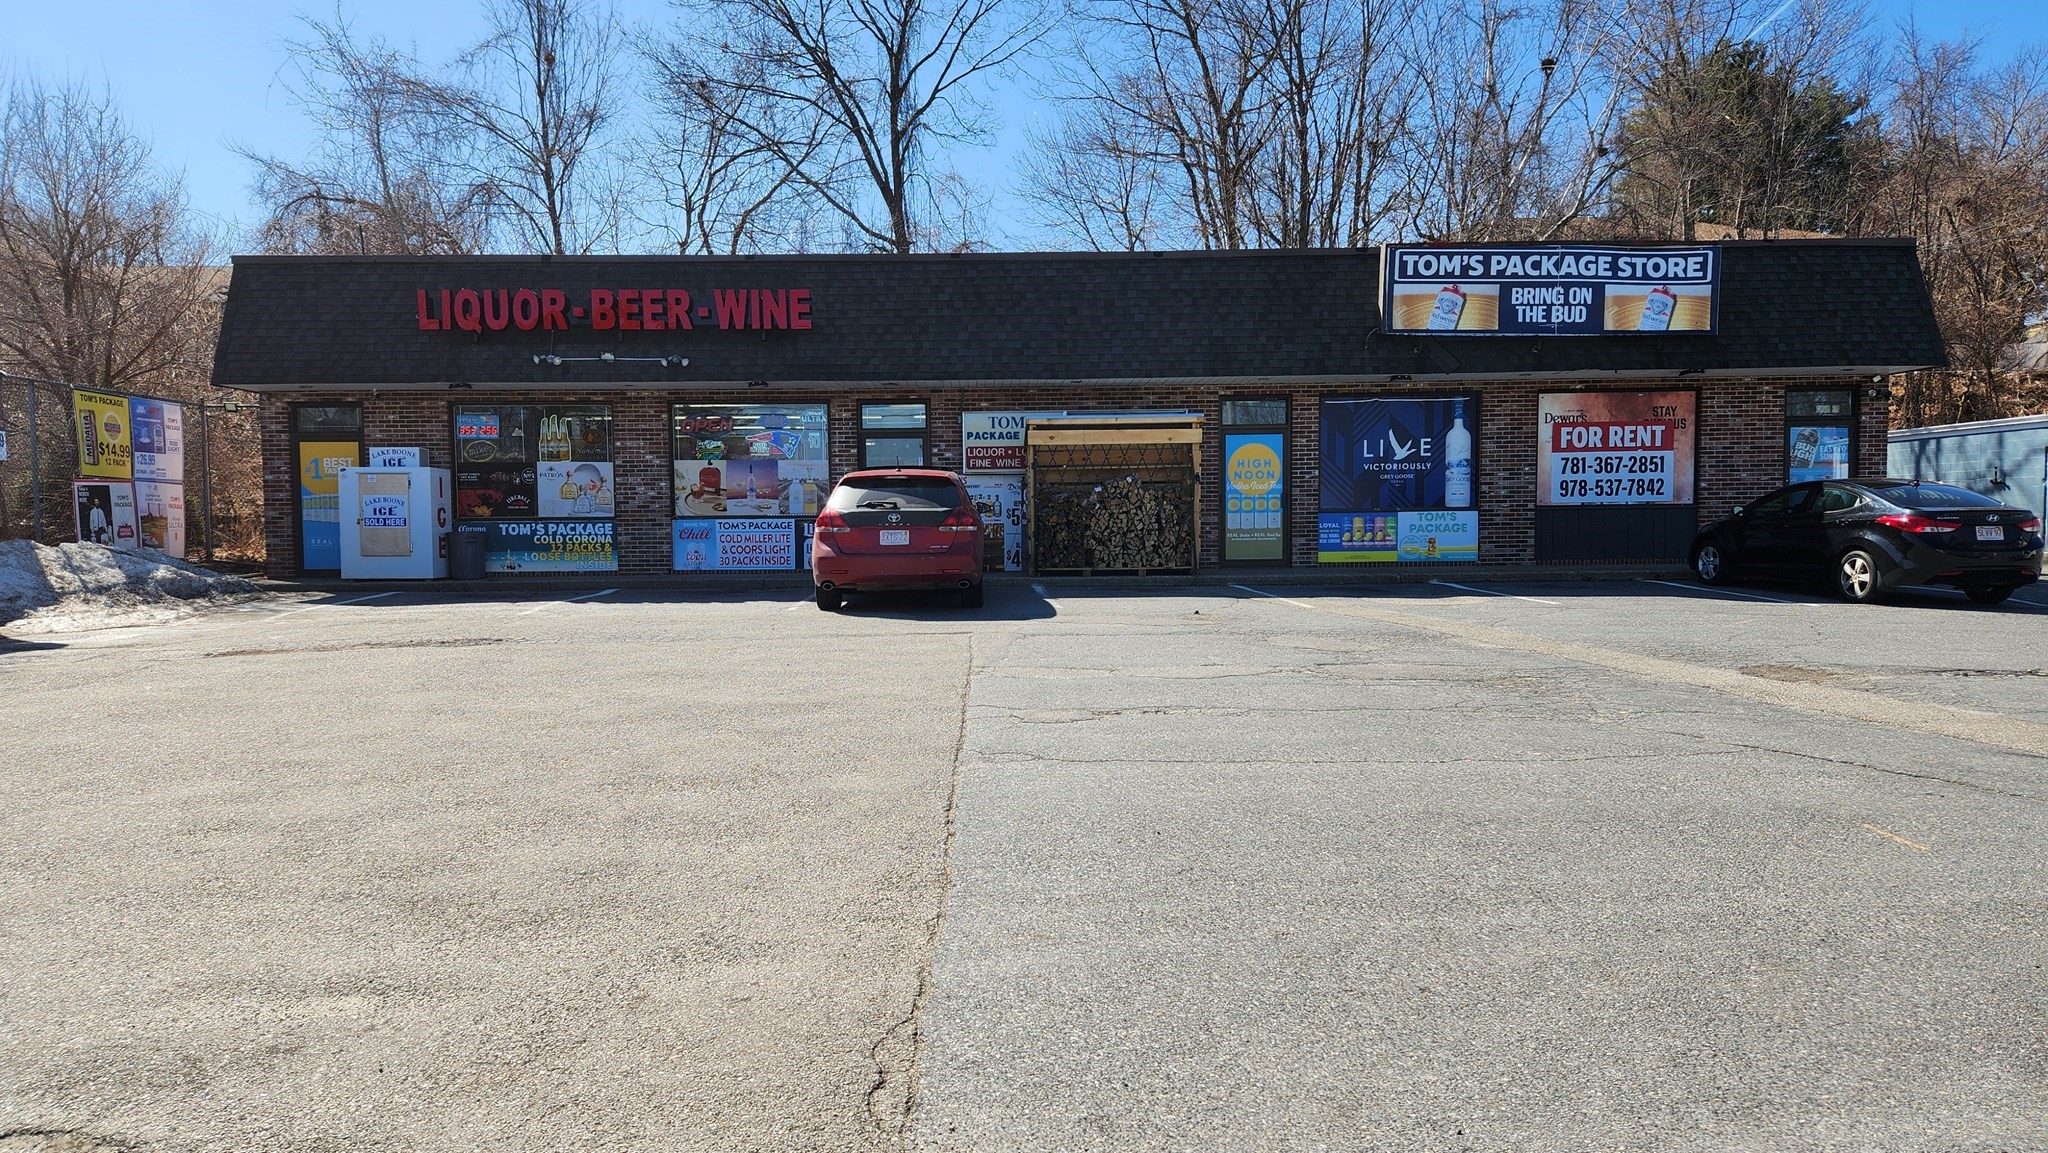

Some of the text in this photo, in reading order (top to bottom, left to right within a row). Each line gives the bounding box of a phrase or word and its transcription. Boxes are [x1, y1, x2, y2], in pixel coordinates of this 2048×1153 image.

[1402, 254, 1704, 278] TOM'S PACKAGE STORE
[1511, 287, 1593, 306] BRING ON
[416, 287, 813, 333] LIQUOR BEER WINE
[1516, 305, 1587, 323] THE BUD
[80, 394, 124, 407] TOM'S PACKAGE
[1652, 405, 1678, 417] STAY
[988, 416, 1025, 429] TOM
[1544, 412, 1588, 424] Dewar's
[681, 418, 734, 433] OPEN
[82, 415, 93, 457] MEDALLA
[966, 431, 1020, 440] PACKAGE
[1560, 425, 1666, 449] FOR RENT
[98, 442, 130, 458] $14.99
[967, 448, 1005, 457] LIQUOR
[1794, 441, 1816, 454] BUD
[371, 448, 417, 459] LAKE BOONE
[105, 458, 126, 467] 12 PACK
[323, 457, 354, 468] BEST
[382, 457, 406, 467] ICE
[970, 458, 1022, 467] FINE WINE
[1237, 459, 1272, 468] HIGH
[1363, 463, 1432, 471] VICTORIOUSLY
[1560, 455, 1665, 475] 781-367-2851
[1233, 470, 1275, 480] NOON
[1226, 480, 1282, 490] Vodka Iced Tea
[1559, 478, 1665, 497] 978-537-7842
[364, 496, 406, 507] LAKE BOONE
[372, 506, 398, 516] ICE
[365, 518, 405, 526] SOLD HERE
[1417, 512, 1457, 522] TOM'S
[169, 521, 184, 529] ULTRA
[458, 525, 487, 533] Corona
[499, 523, 613, 536] TOM'S PACKAGE
[718, 521, 793, 530] TOM'S PACKAGE
[1409, 523, 1468, 533] PACKAGE
[678, 528, 713, 540] Chill
[720, 533, 791, 543] COLD MILLER LITE
[899, 533, 908, 541] 22
[533, 535, 613, 544] COLD CORONA
[550, 544, 613, 553] 12 PACKS &
[721, 545, 791, 555] & COORS LIGHT
[524, 552, 613, 561] LOOSE BOTTLES
[720, 556, 791, 565] 30 PACKS INSIDE
[575, 561, 613, 569] INSIDE
